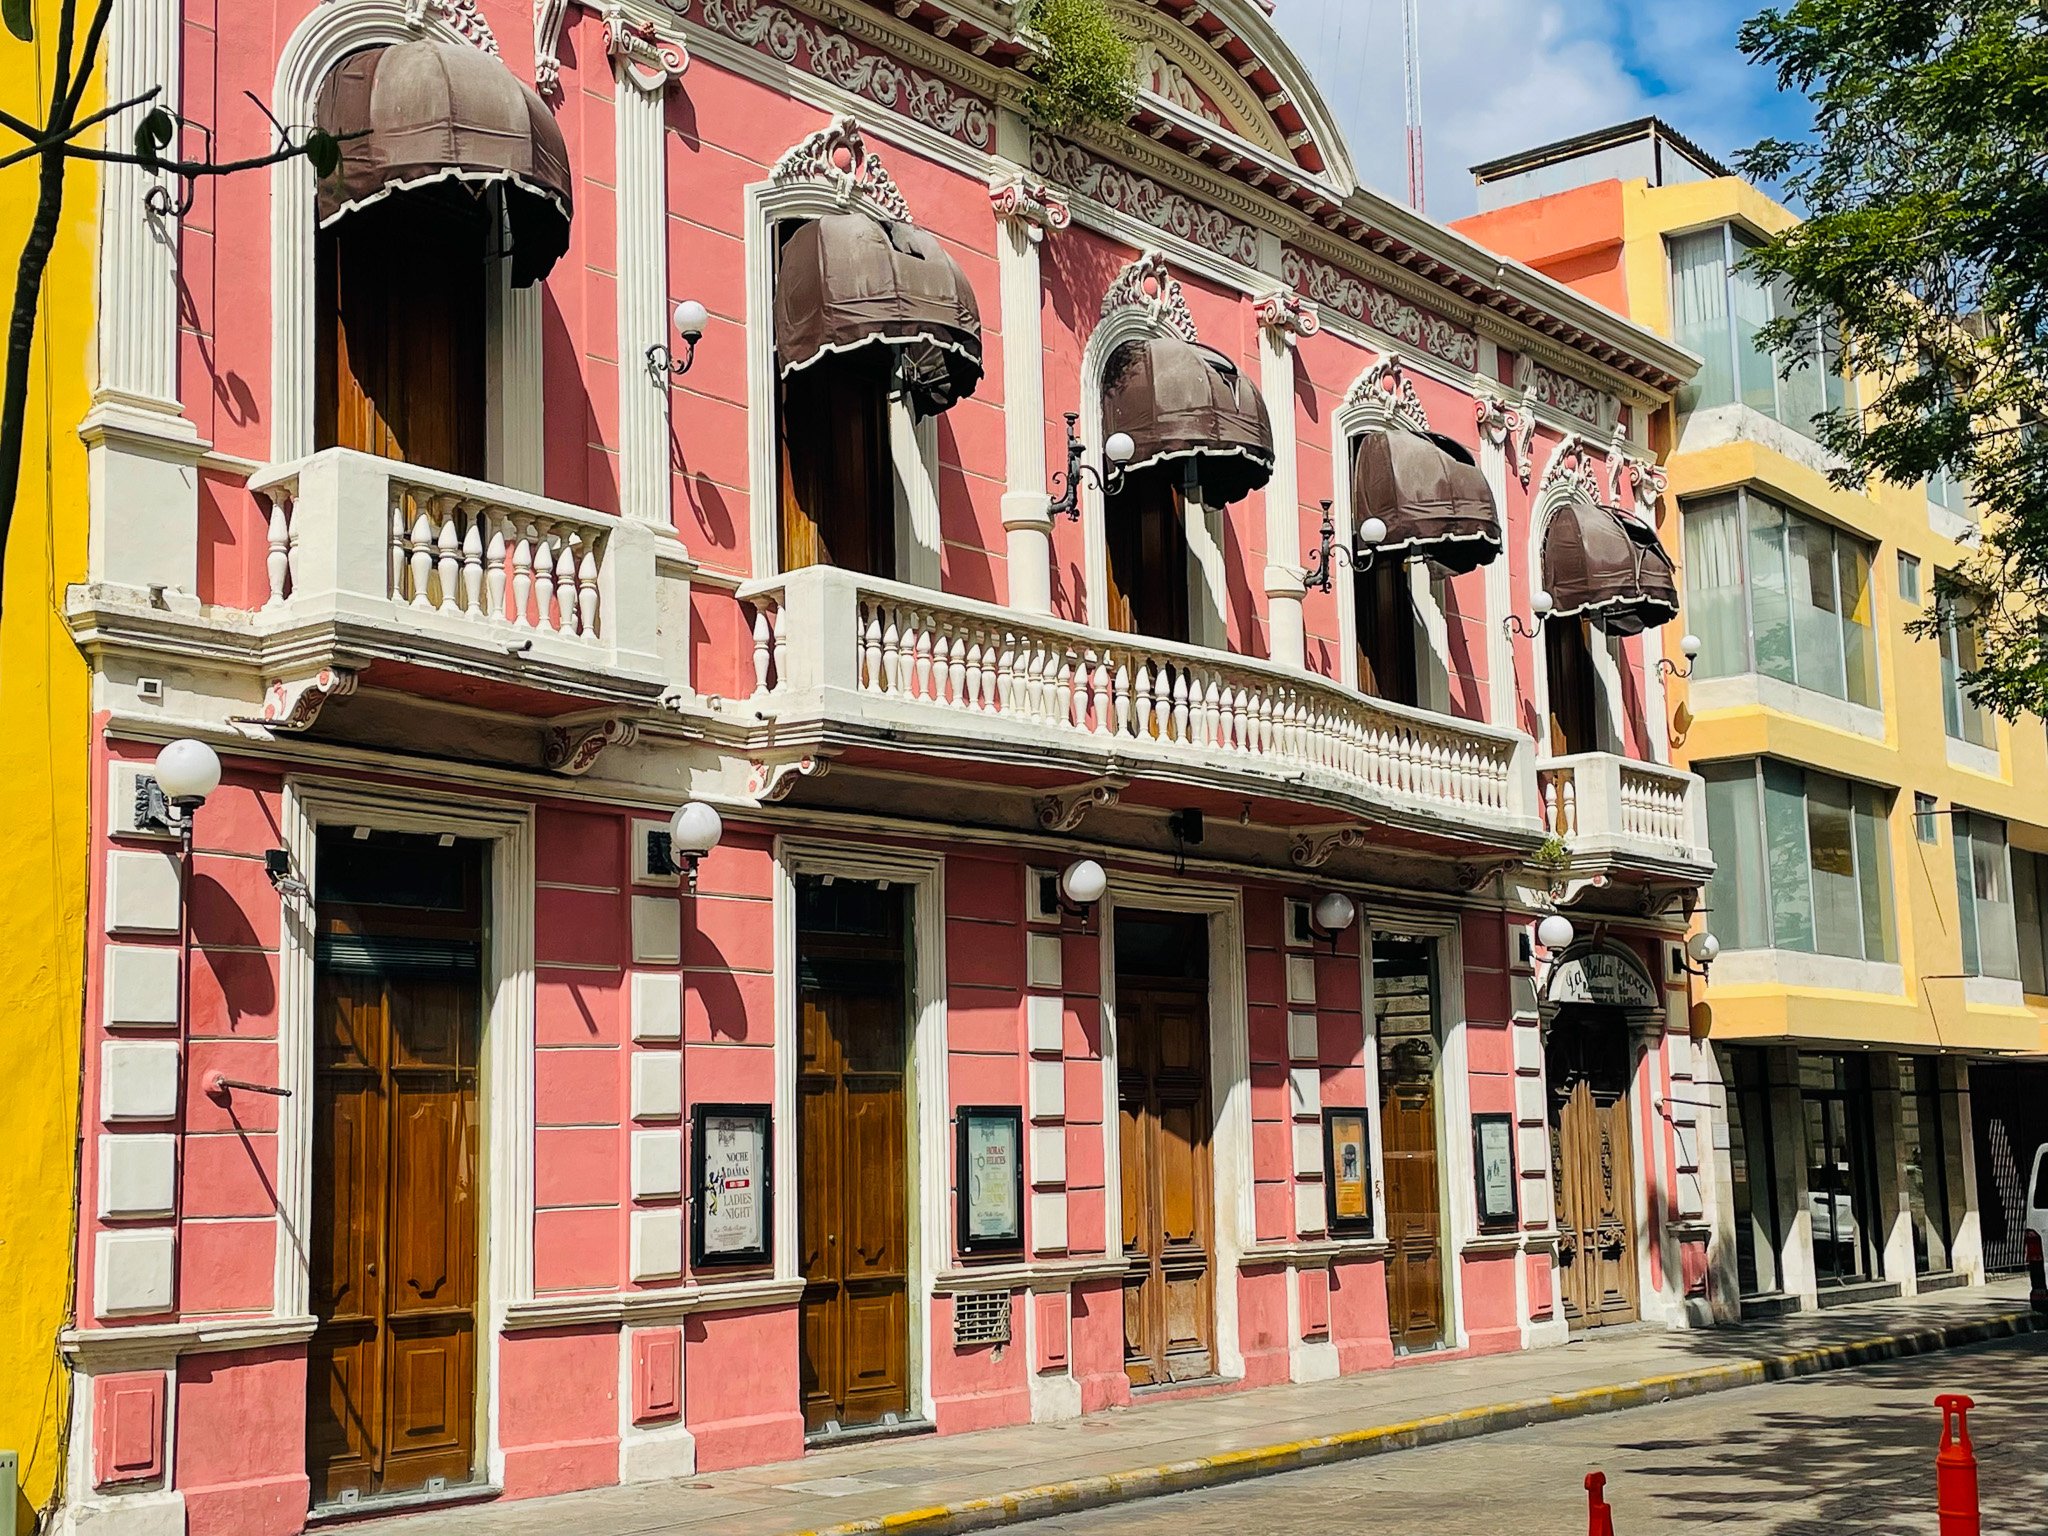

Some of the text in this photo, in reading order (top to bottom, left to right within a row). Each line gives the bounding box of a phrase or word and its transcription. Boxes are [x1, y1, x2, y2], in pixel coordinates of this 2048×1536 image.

[1566, 970, 1583, 996] La
[1584, 956, 1613, 980] Bella
[726, 1151, 749, 1162] NOCHE
[727, 1166, 749, 1178] DAMAS
[724, 1192, 752, 1206] LADIES
[726, 1206, 751, 1220] NIGHT
